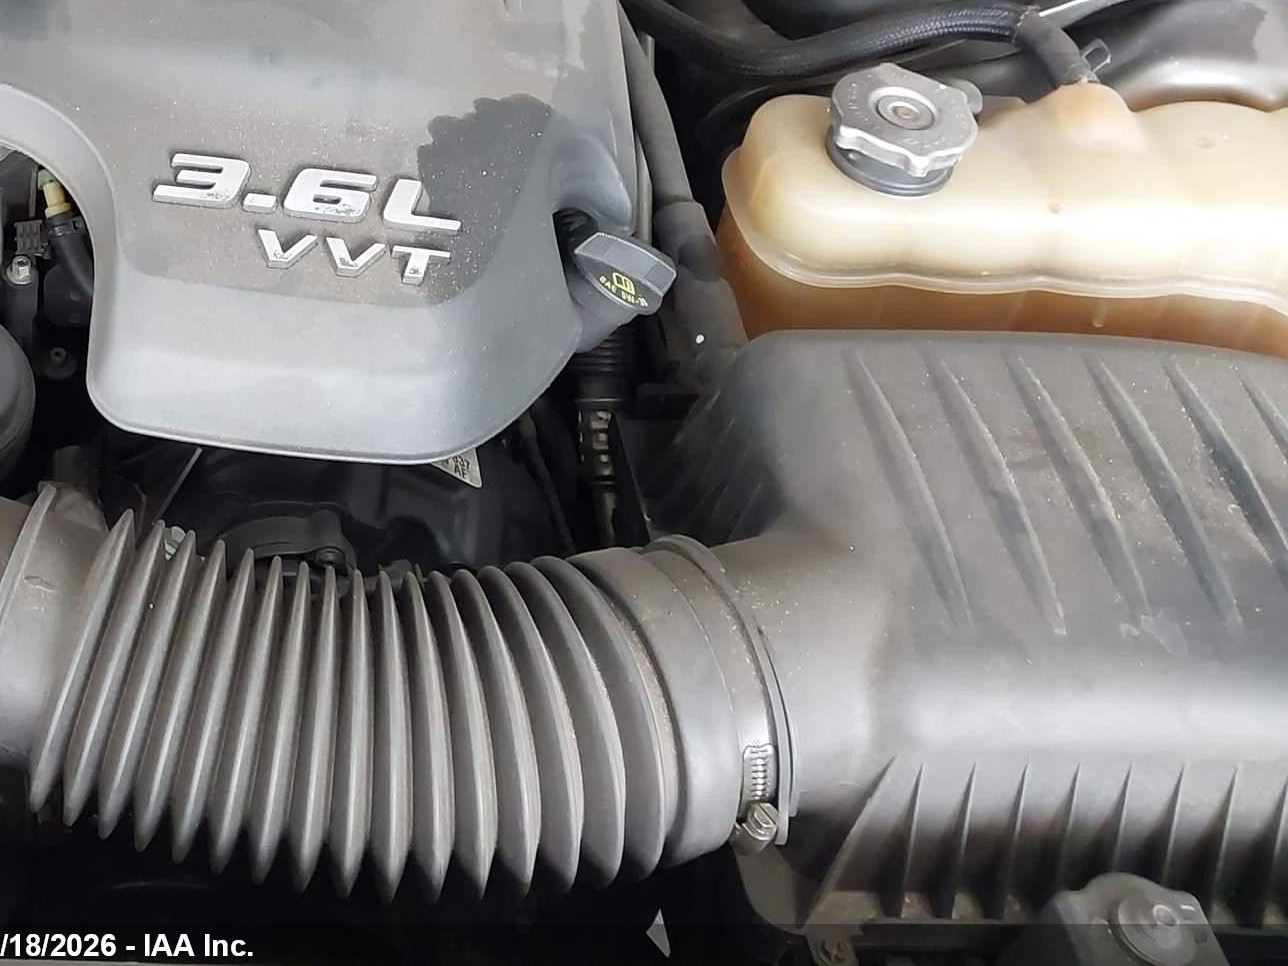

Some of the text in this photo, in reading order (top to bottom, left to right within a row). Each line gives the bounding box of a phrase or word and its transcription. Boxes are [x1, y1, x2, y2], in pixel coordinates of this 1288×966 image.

[152, 152, 462, 234] 3.6L
[258, 228, 451, 286] VVT
[599, 275, 617, 293] SAE
